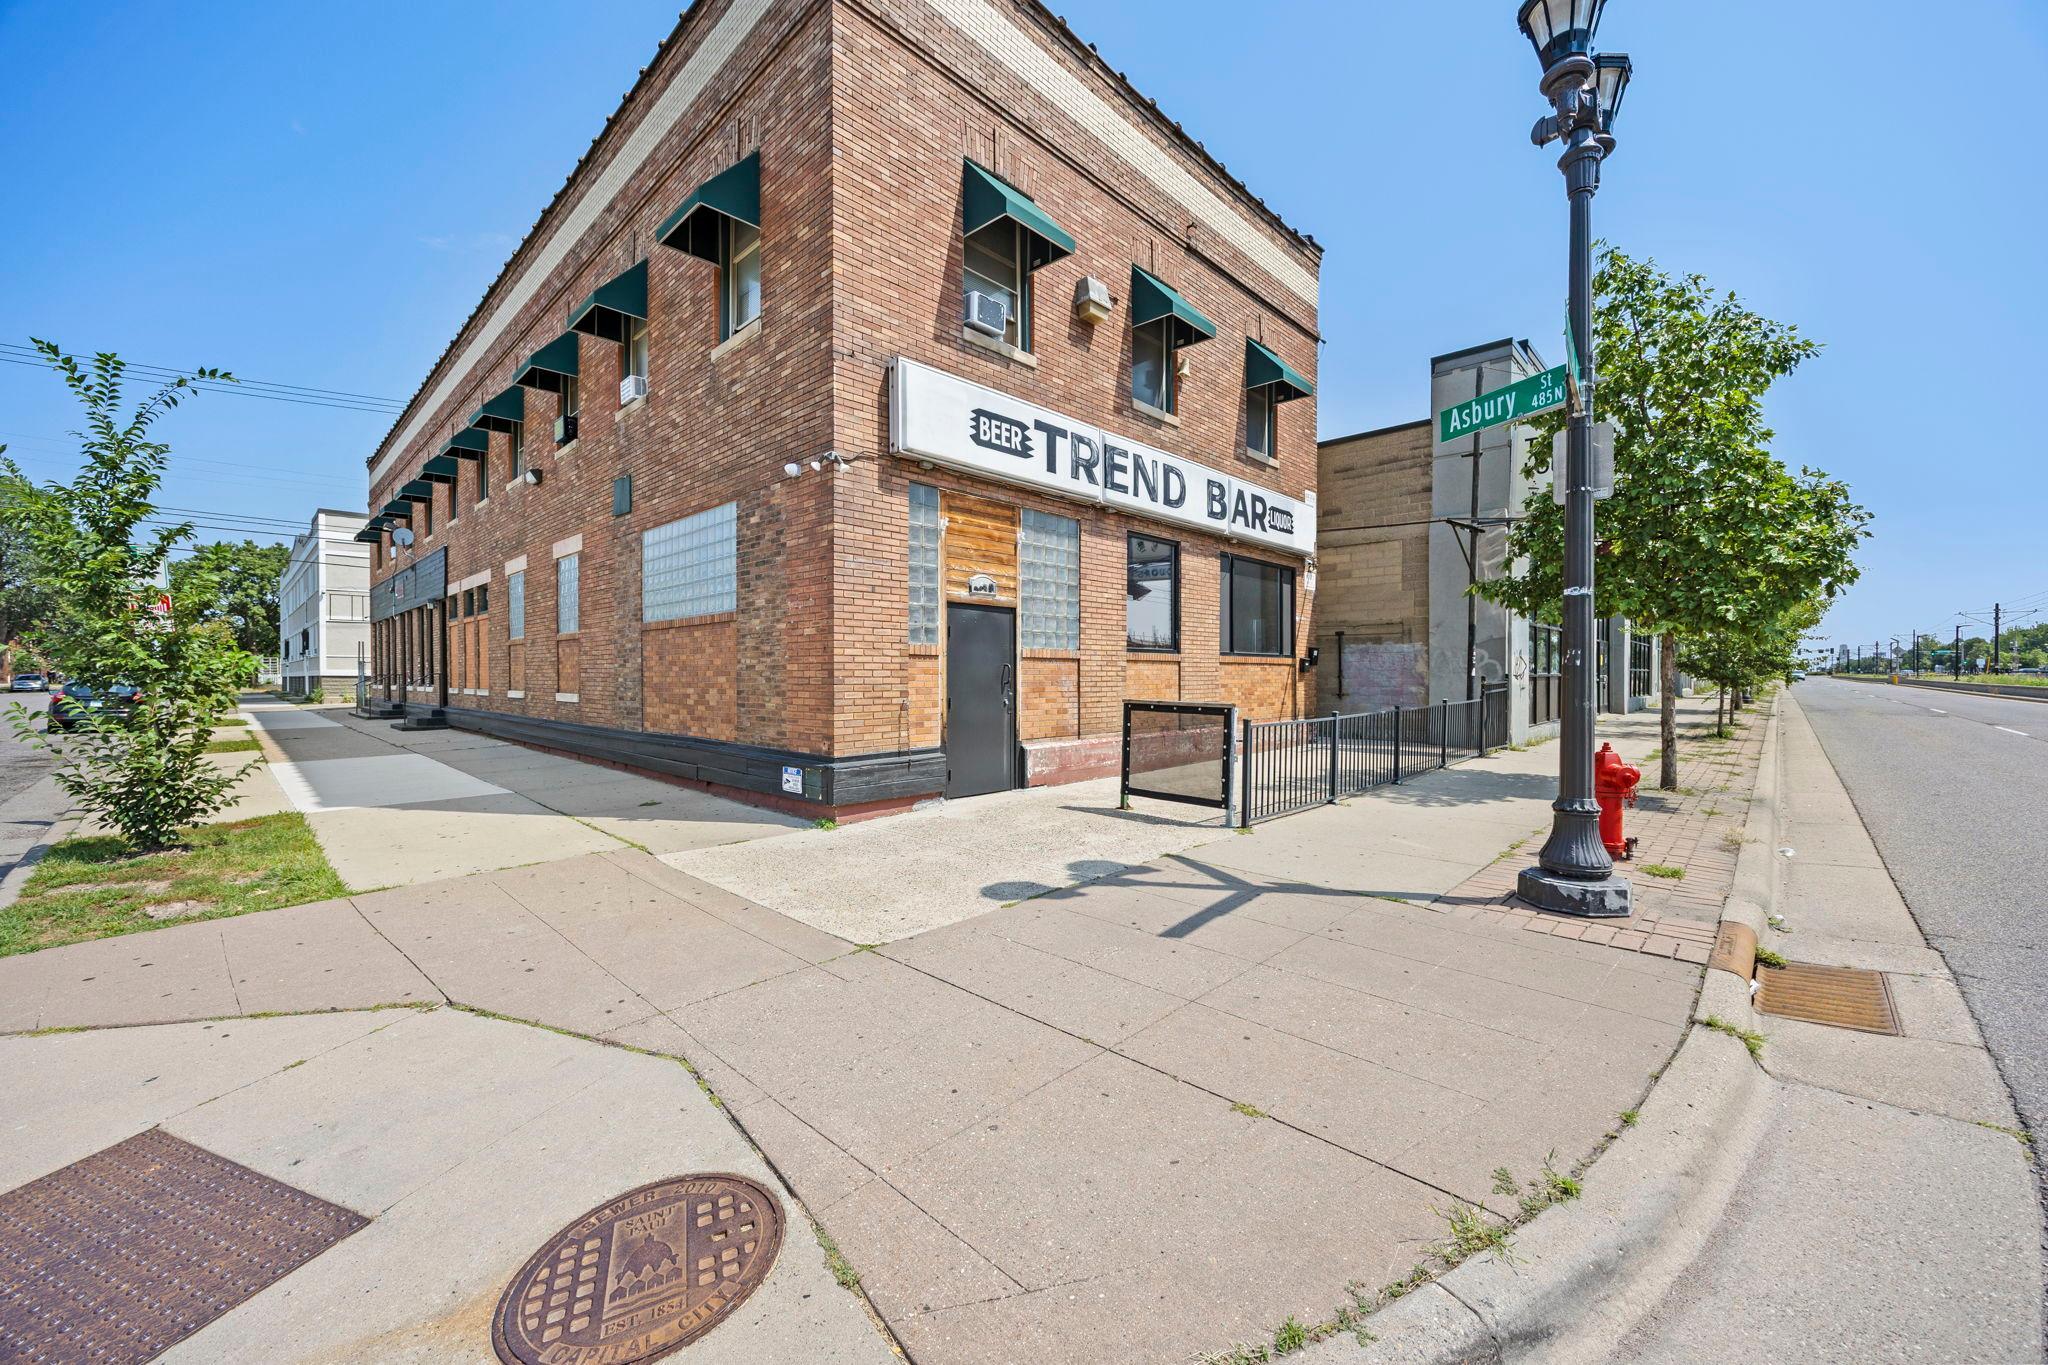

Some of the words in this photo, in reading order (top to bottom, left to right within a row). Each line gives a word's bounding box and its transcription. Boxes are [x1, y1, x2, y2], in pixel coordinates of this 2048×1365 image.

[1449, 391, 1516, 433] Asbury
[1540, 373, 1552, 389] St
[1531, 390, 1552, 408] 485
[1554, 386, 1563, 400] N
[979, 416, 1023, 452] BEER
[1034, 419, 1187, 508] TREND
[1206, 479, 1268, 533] BAR
[1270, 509, 1292, 531] LIQUOR
[581, 1190, 656, 1232] SEWER
[674, 1181, 718, 1194] 2010
[625, 1206, 676, 1229] SAINT
[629, 1217, 667, 1236] PAUL
[651, 1296, 683, 1319] 1854
[550, 1334, 657, 1365] CAPITAL
[678, 1289, 728, 1330] CITY
